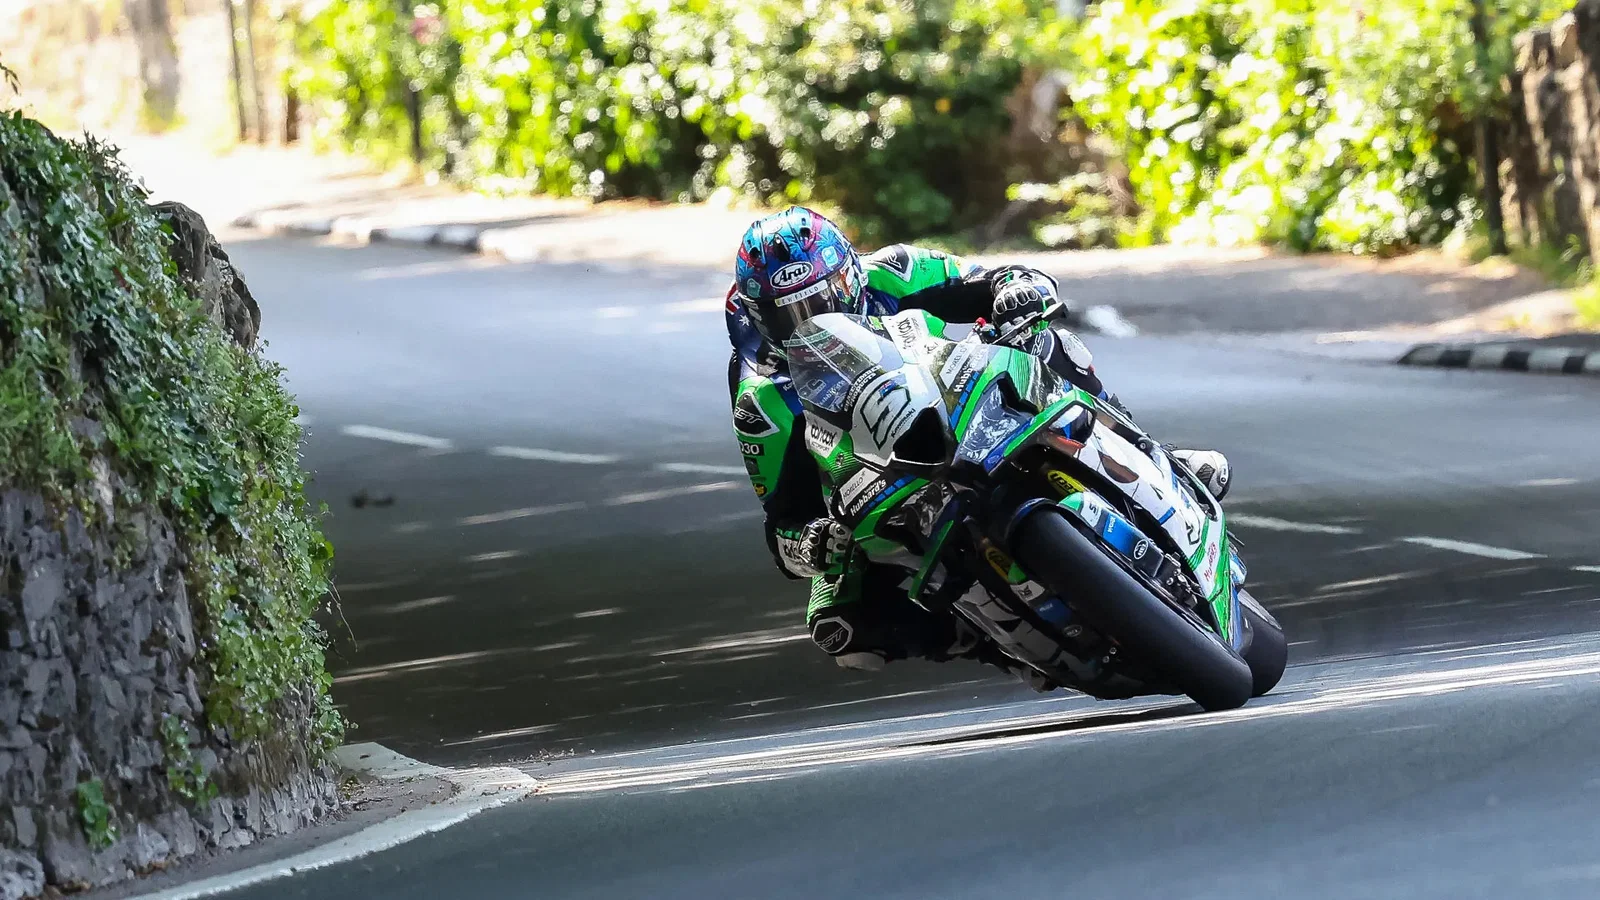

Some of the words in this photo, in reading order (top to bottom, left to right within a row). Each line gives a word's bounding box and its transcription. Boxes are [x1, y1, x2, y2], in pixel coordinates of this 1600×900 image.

[778, 263, 807, 283] Arai
[891, 408, 916, 438] Kawasaki
[850, 479, 887, 517] Hubbard's
